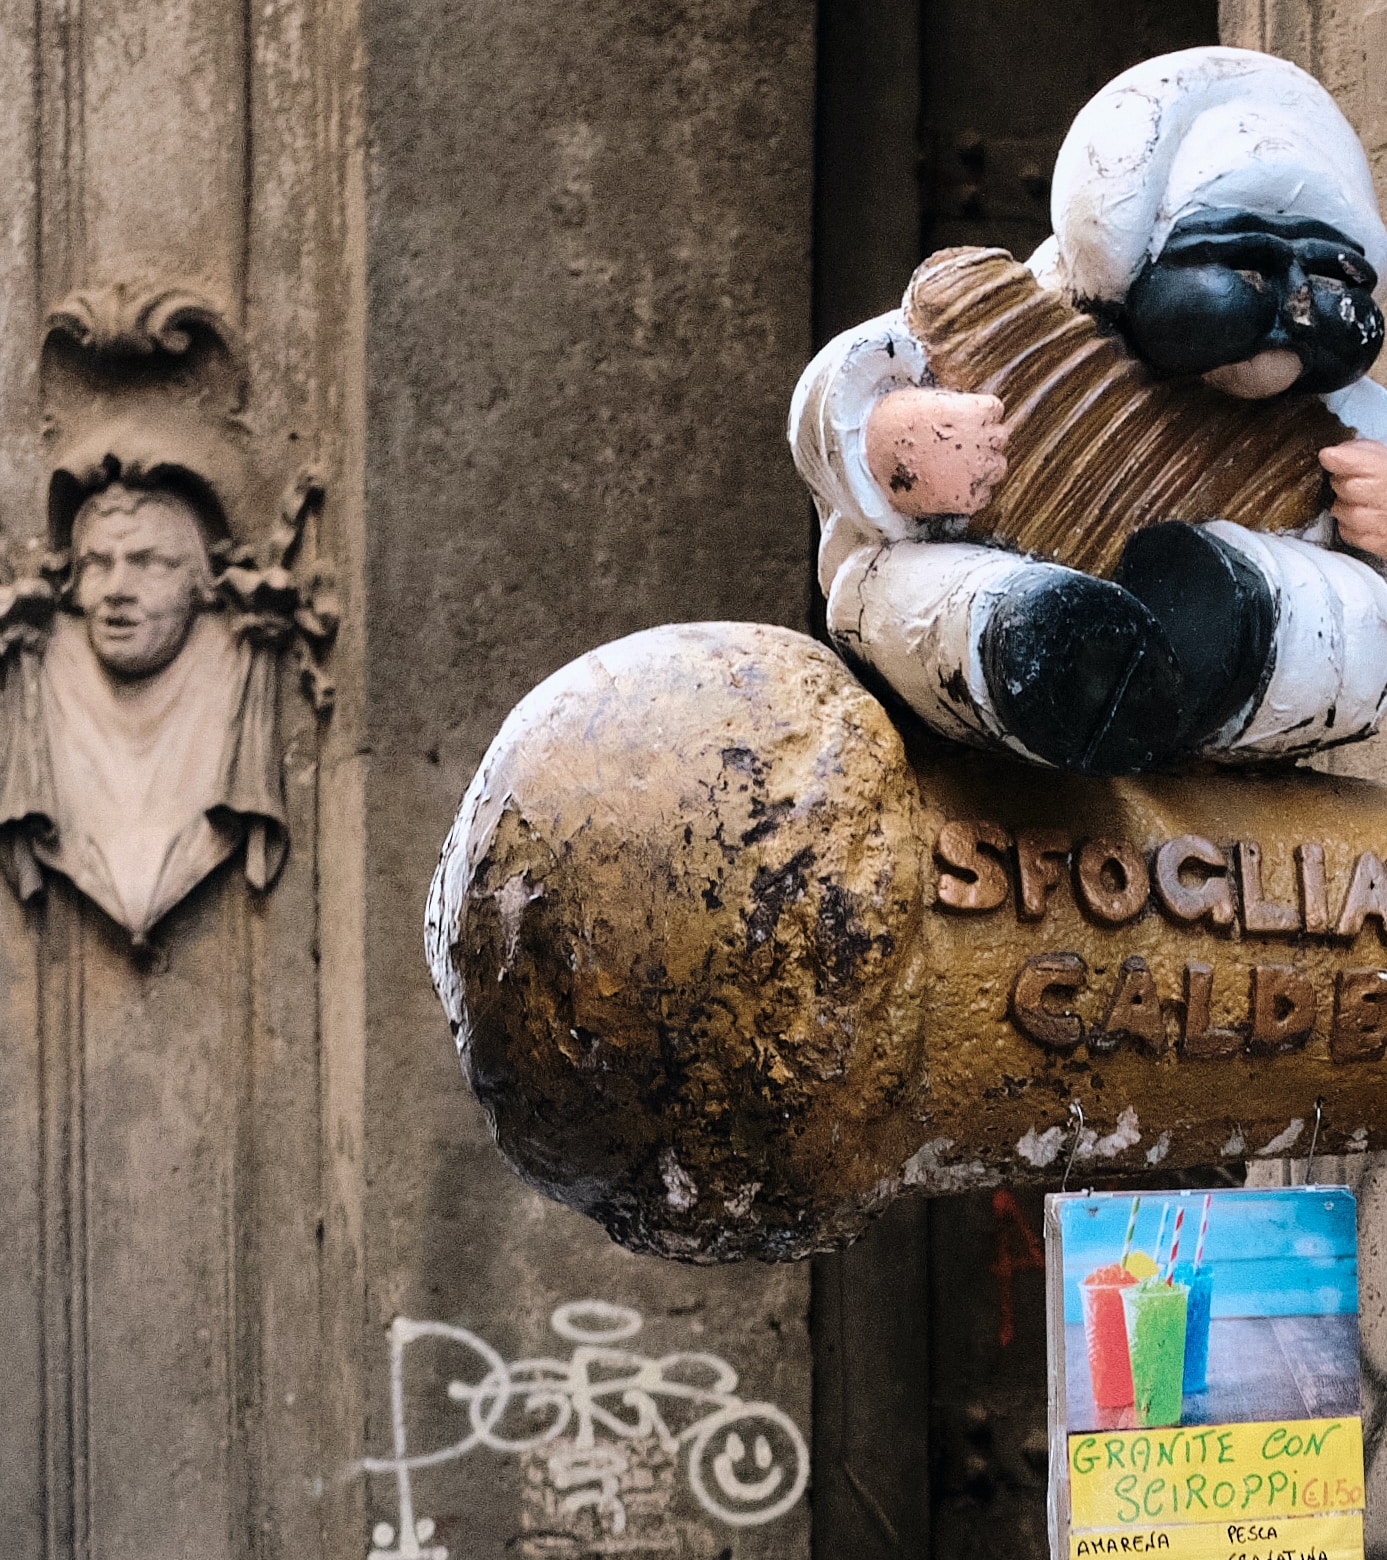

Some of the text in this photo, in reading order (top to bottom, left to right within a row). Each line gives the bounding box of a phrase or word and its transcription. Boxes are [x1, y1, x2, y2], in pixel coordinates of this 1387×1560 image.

[1072, 1423, 1342, 1474] GRANITE CON
[1113, 1469, 1297, 1523] SCIROPPI
[1077, 1531, 1170, 1557] AMARENA
[1227, 1524, 1278, 1544] PESCA
